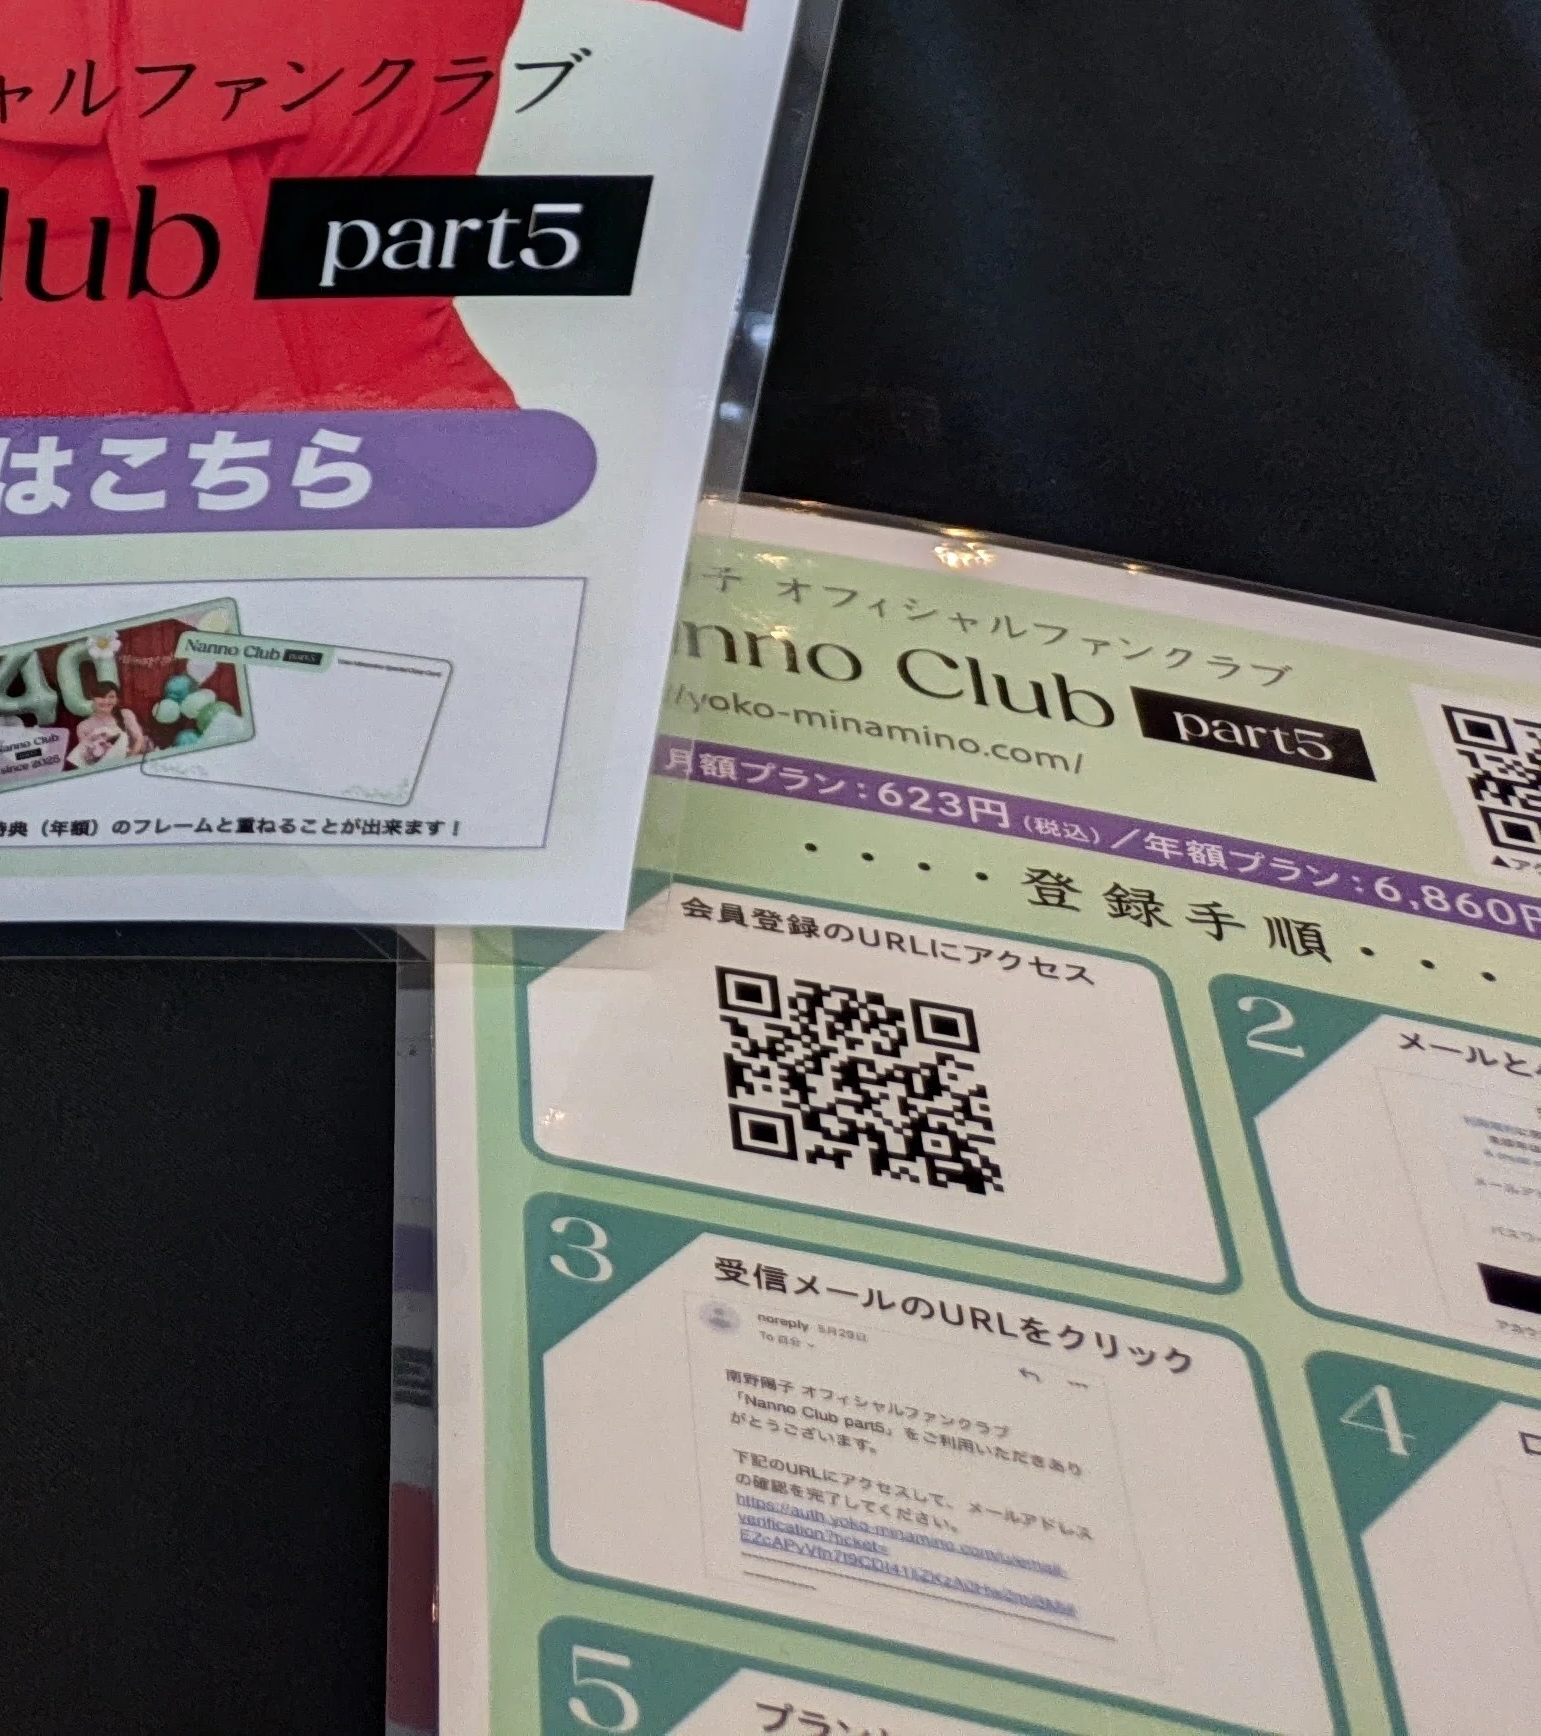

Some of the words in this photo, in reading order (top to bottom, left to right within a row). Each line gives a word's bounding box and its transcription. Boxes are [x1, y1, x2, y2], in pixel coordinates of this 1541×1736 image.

[318, 201, 585, 289] part5
[184, 638, 239, 658] Nanno
[242, 642, 281, 661] Club
[775, 577, 1294, 689] オフィシャルファンクラブ
[680, 619, 863, 682] nno
[896, 647, 1116, 730] Club
[1172, 703, 1335, 765] part5
[681, 896, 1096, 986] 会員登録のURLにアクセス
[1022, 867, 1334, 965] 登録手順
[1237, 996, 1305, 1059] 2
[1399, 1032, 1541, 1079] メールと
[548, 1215, 615, 1284] 3
[714, 1255, 1194, 1378] 受信メールのURLをクリック
[725, 1368, 795, 1394] 南野陽子
[1340, 1384, 1416, 1458] 4
[567, 1644, 640, 1732] 5
